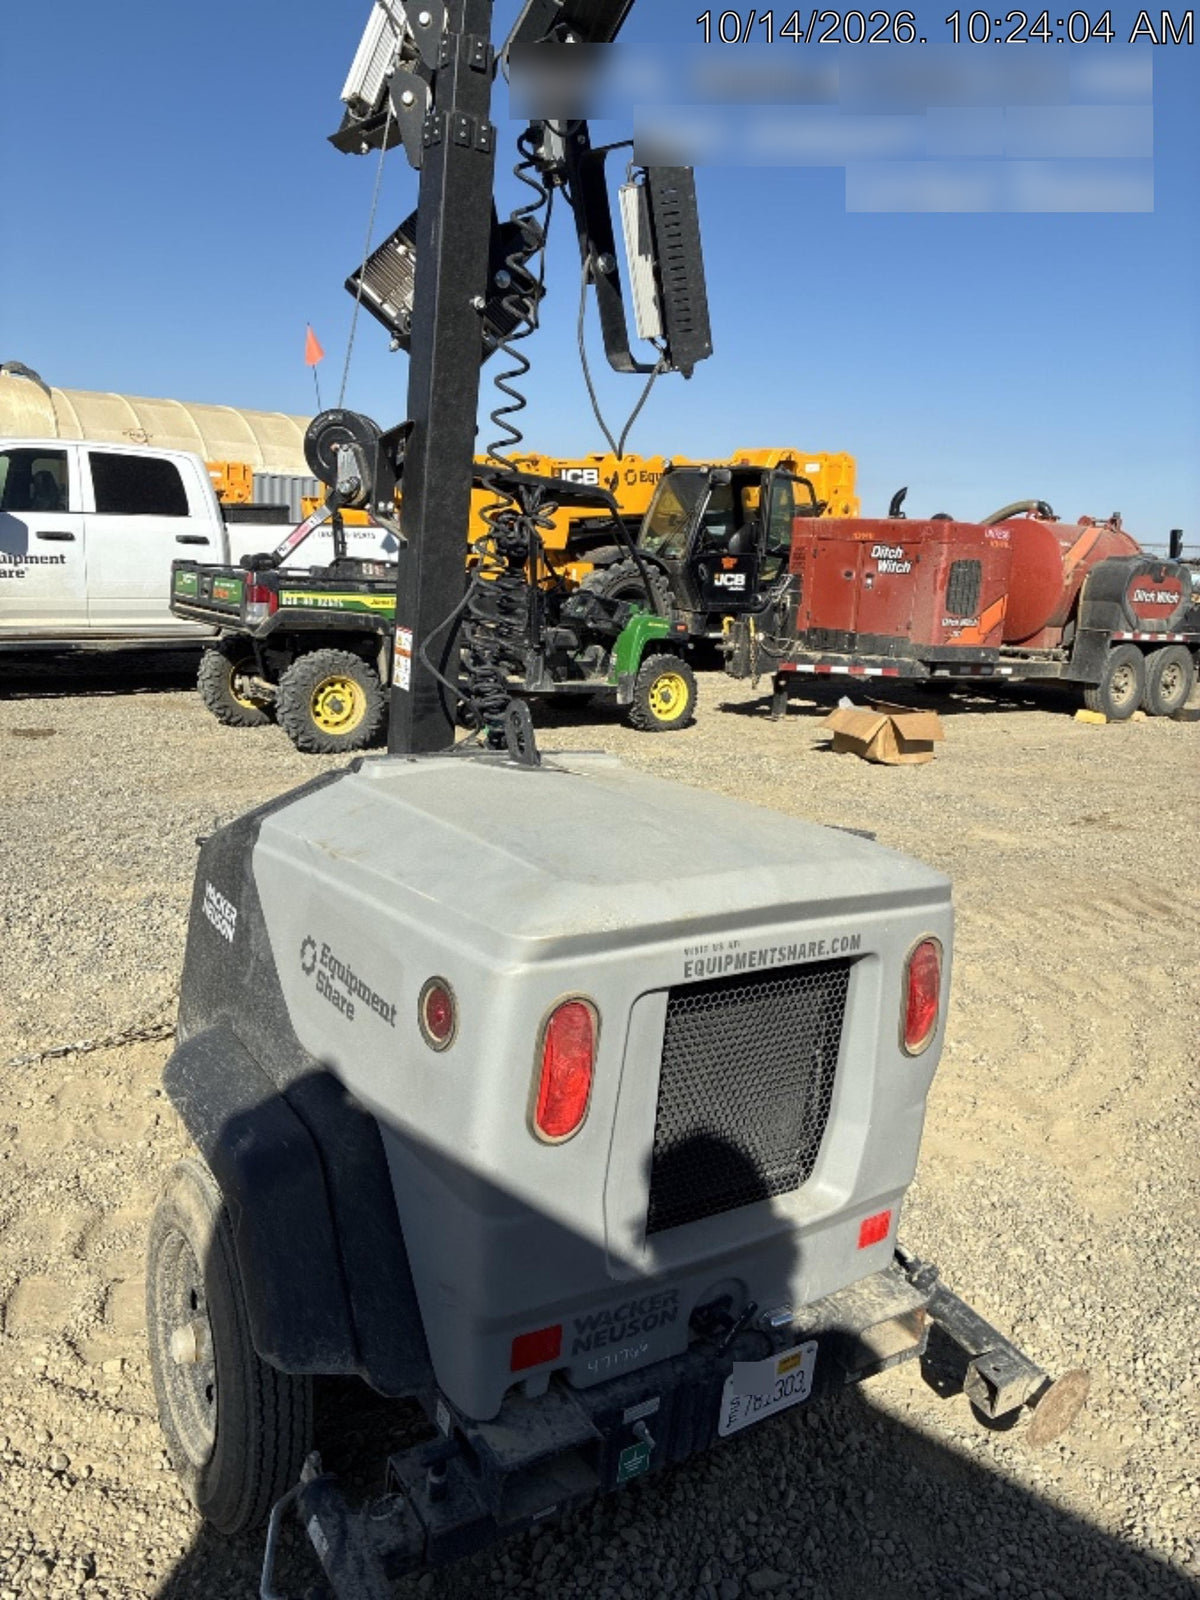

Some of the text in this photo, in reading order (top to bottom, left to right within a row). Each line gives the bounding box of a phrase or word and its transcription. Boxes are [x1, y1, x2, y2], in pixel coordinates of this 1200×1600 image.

[870, 545, 904, 559] Ditch
[877, 559, 912, 574] Witch
[714, 573, 745, 586] JCB
[202, 897, 236, 943] NEUSON
[205, 879, 237, 926] WACKER
[684, 934, 861, 978] EQUIPMENTSHARE.COM
[316, 969, 355, 1022] Share
[320, 942, 397, 1028] Equipment
[571, 1305, 680, 1356] NEUSON
[572, 1288, 681, 1335] WACKER
